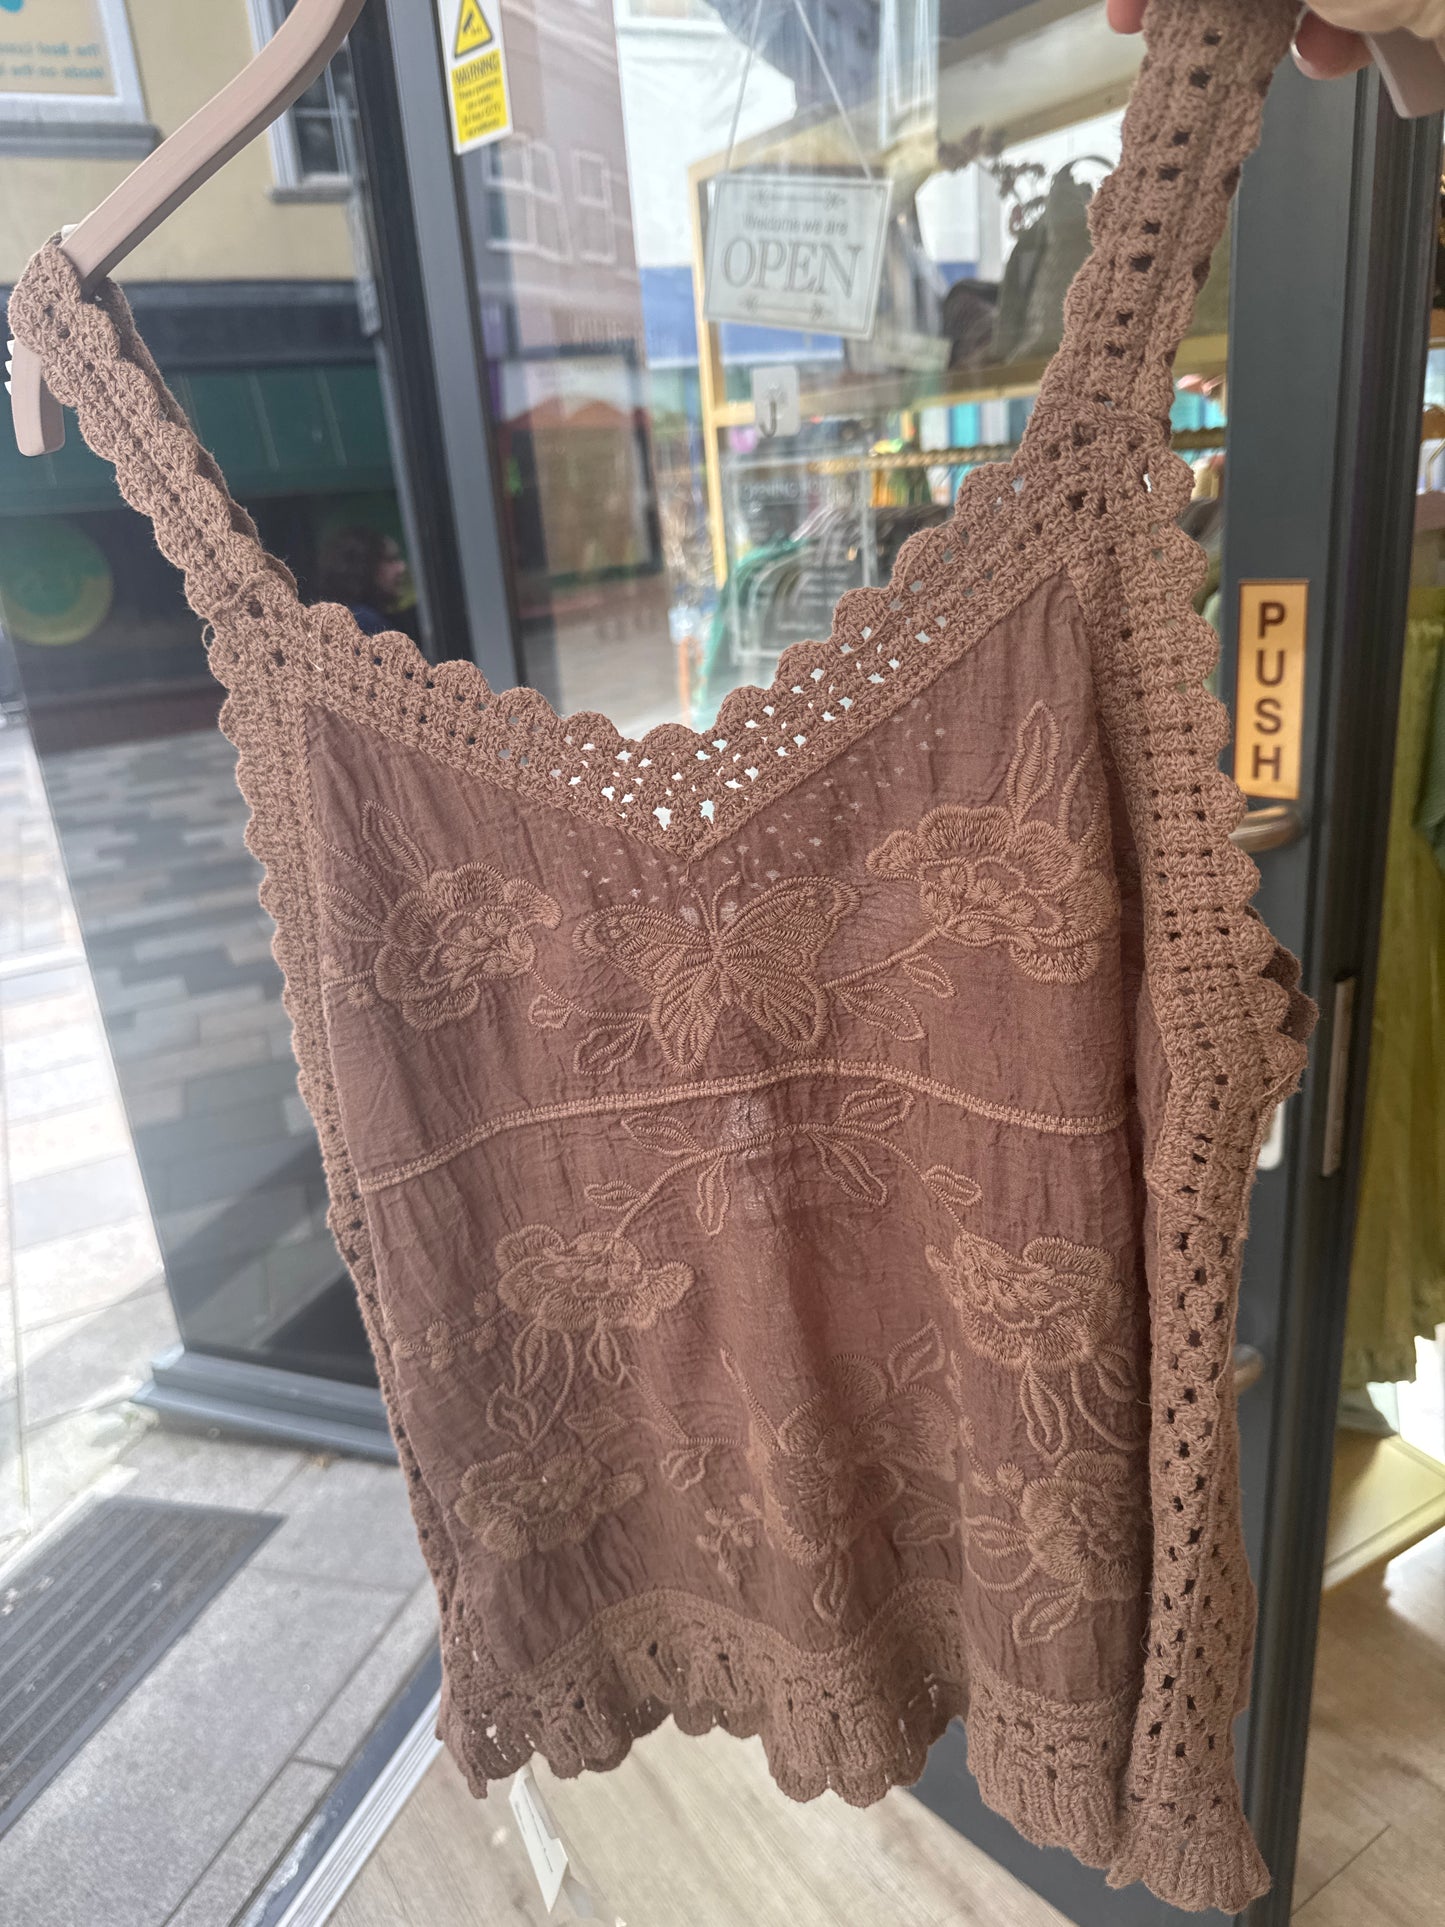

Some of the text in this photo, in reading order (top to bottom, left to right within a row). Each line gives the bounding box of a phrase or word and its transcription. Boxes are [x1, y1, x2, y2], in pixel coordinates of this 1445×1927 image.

[744, 214, 848, 236] Welcome we are
[722, 237, 863, 298] OPEN
[1252, 601, 1286, 781] PUSH
